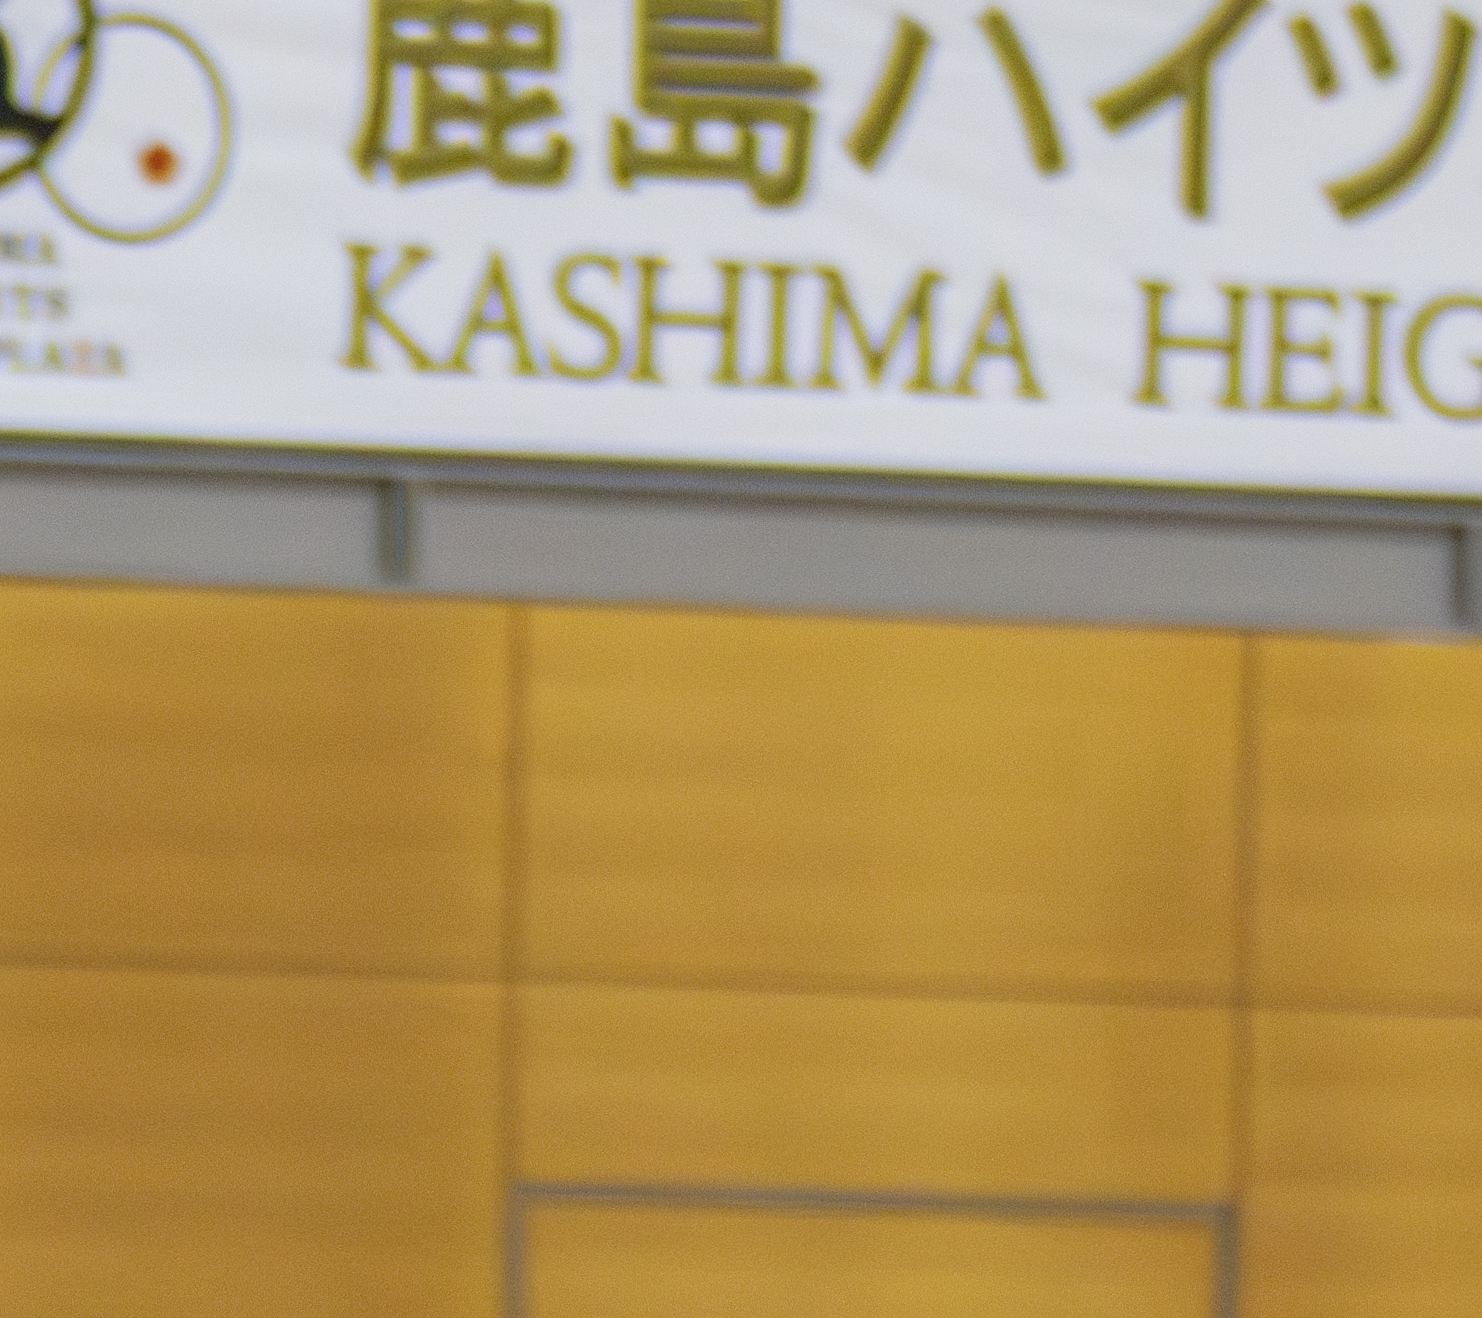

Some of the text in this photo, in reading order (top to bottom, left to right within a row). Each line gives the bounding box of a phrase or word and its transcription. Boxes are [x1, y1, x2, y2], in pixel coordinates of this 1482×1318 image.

[349, 0, 1478, 221] 鹿島ハイツ
[336, 242, 1482, 421] KASHIMA HEIG
